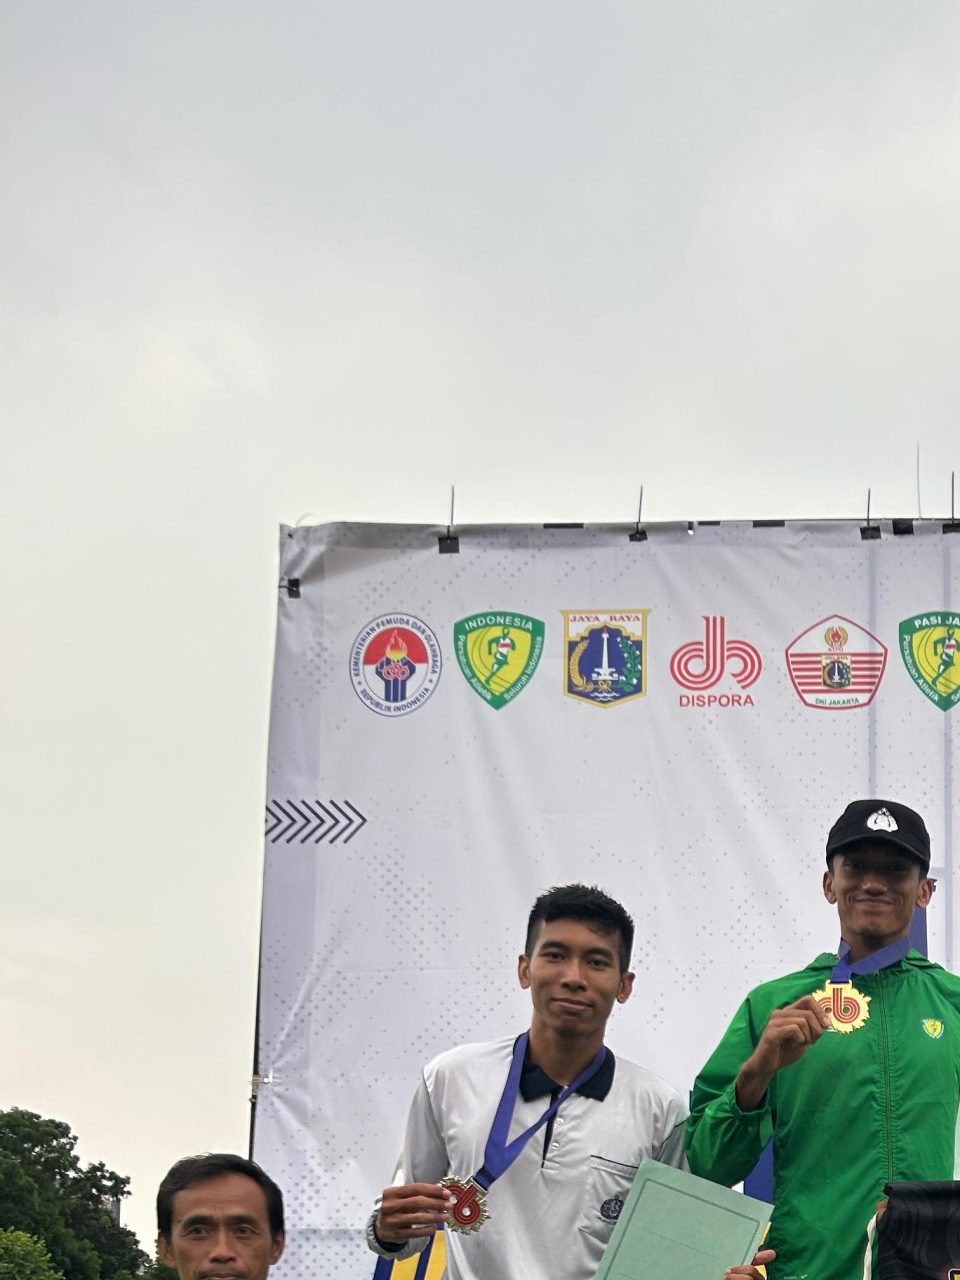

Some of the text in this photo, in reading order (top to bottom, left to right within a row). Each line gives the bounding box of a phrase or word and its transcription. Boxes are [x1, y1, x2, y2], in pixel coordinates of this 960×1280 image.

[464, 615, 533, 631] INDONESIA
[570, 615, 641, 623] JAYA RAYA
[914, 616, 942, 628] PASI
[903, 634, 940, 702] Persatuan Atletik
[393, 687, 431, 713] INDONESIA
[679, 694, 755, 707] DISPORA
[828, 697, 860, 706] JAKARTA
